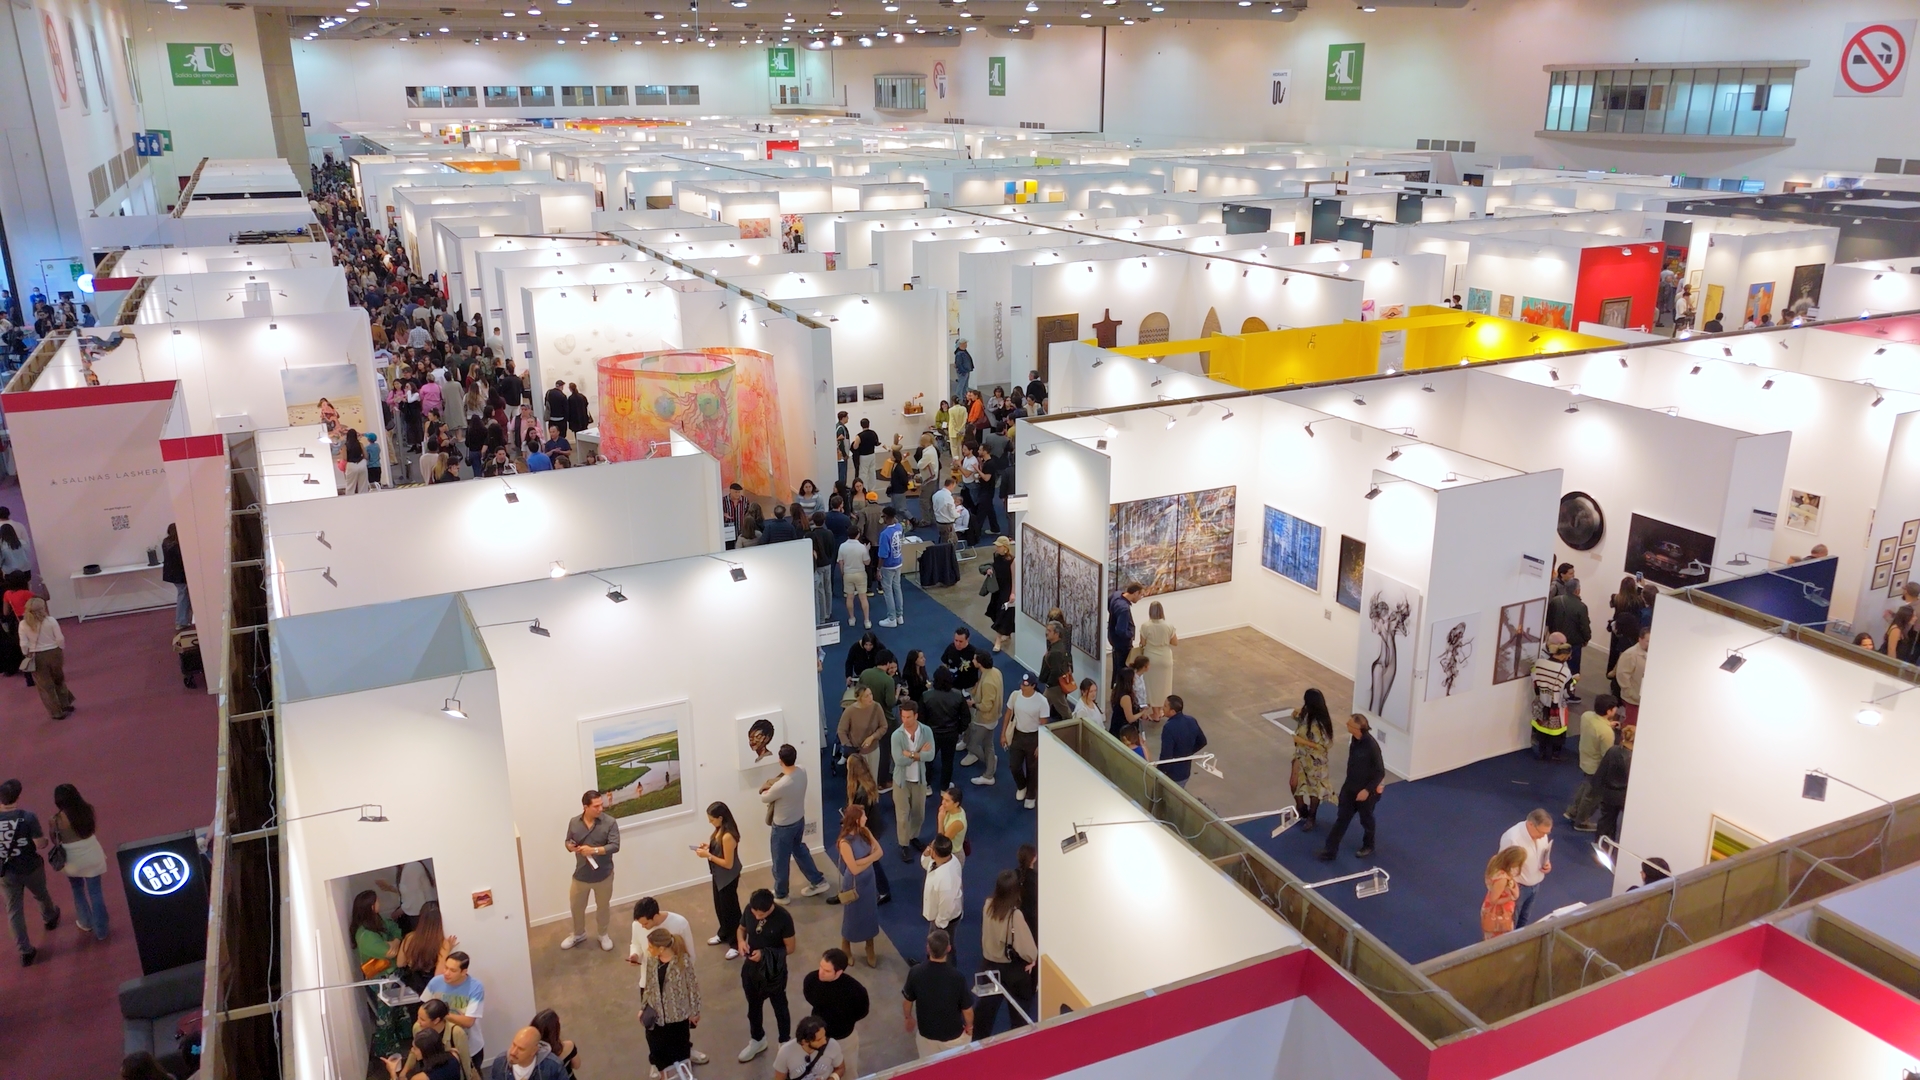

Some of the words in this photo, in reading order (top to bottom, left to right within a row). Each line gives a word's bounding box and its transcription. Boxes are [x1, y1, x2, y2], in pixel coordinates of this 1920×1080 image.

[62, 473, 111, 485] SALINAS
[142, 856, 176, 880] BLU
[149, 867, 181, 890] DOT
